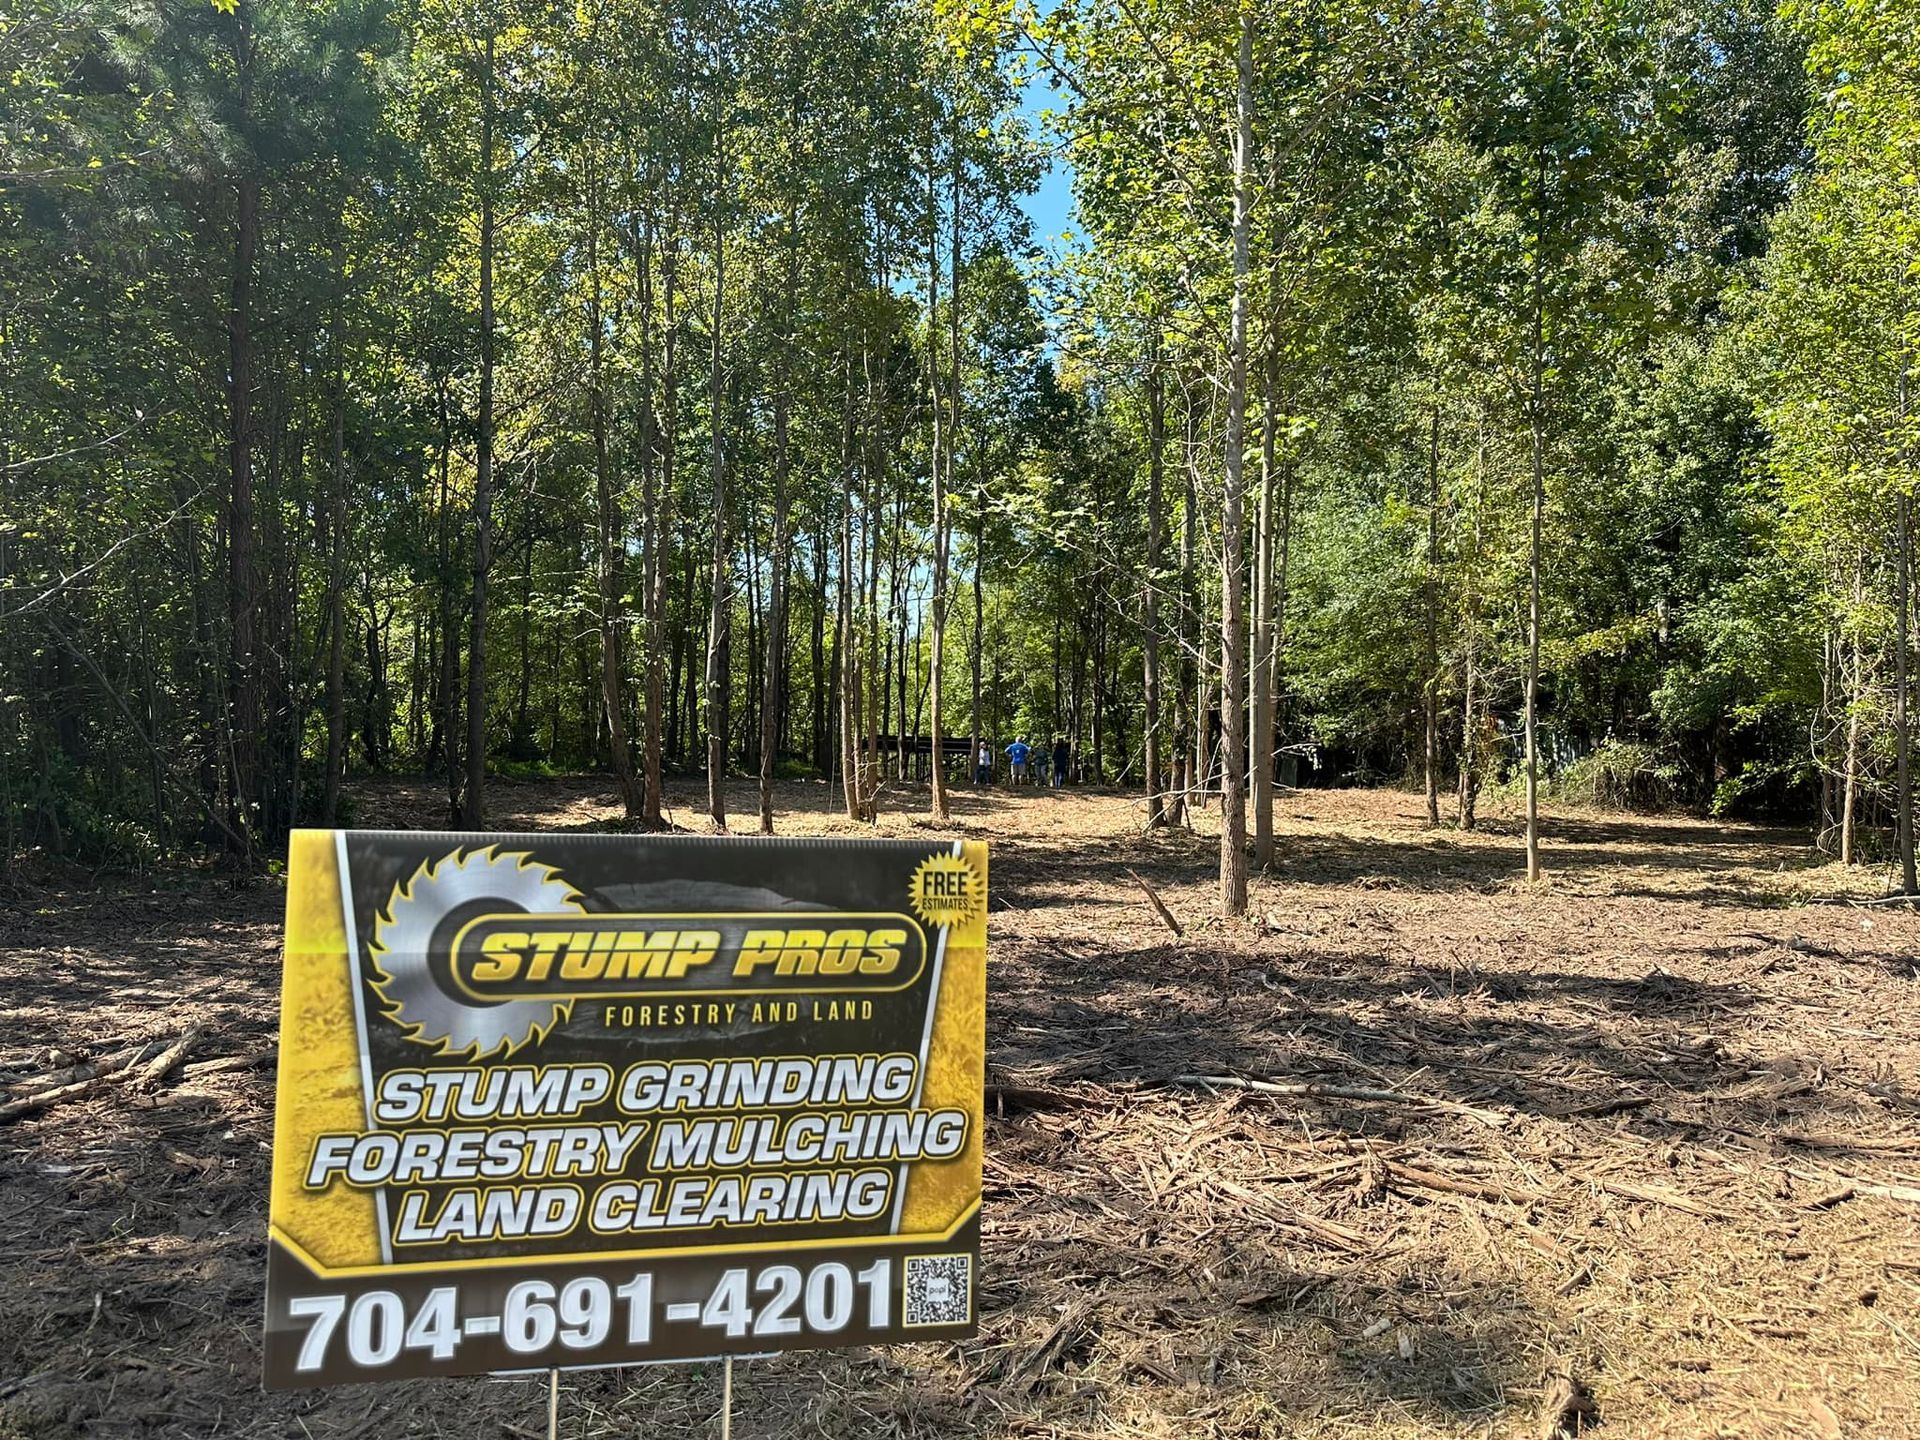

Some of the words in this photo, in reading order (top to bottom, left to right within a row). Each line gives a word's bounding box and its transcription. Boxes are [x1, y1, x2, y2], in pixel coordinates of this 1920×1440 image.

[922, 898, 969, 910] ESTIMATES
[923, 871, 968, 896] FREE
[471, 930, 720, 981] STUMP
[733, 928, 907, 976] PROS
[605, 1005, 736, 1026] FORESTRY
[752, 1003, 798, 1022] AND
[812, 1001, 873, 1021] LAND
[377, 1068, 609, 1121] STUMP
[621, 1057, 913, 1112] GRINDING
[307, 1124, 645, 1187] FORESTRY
[652, 1111, 967, 1171] MULCHING
[396, 1187, 578, 1243] LAND
[589, 1172, 890, 1230] CLEARING
[288, 1258, 893, 1371] 704-691-4201
